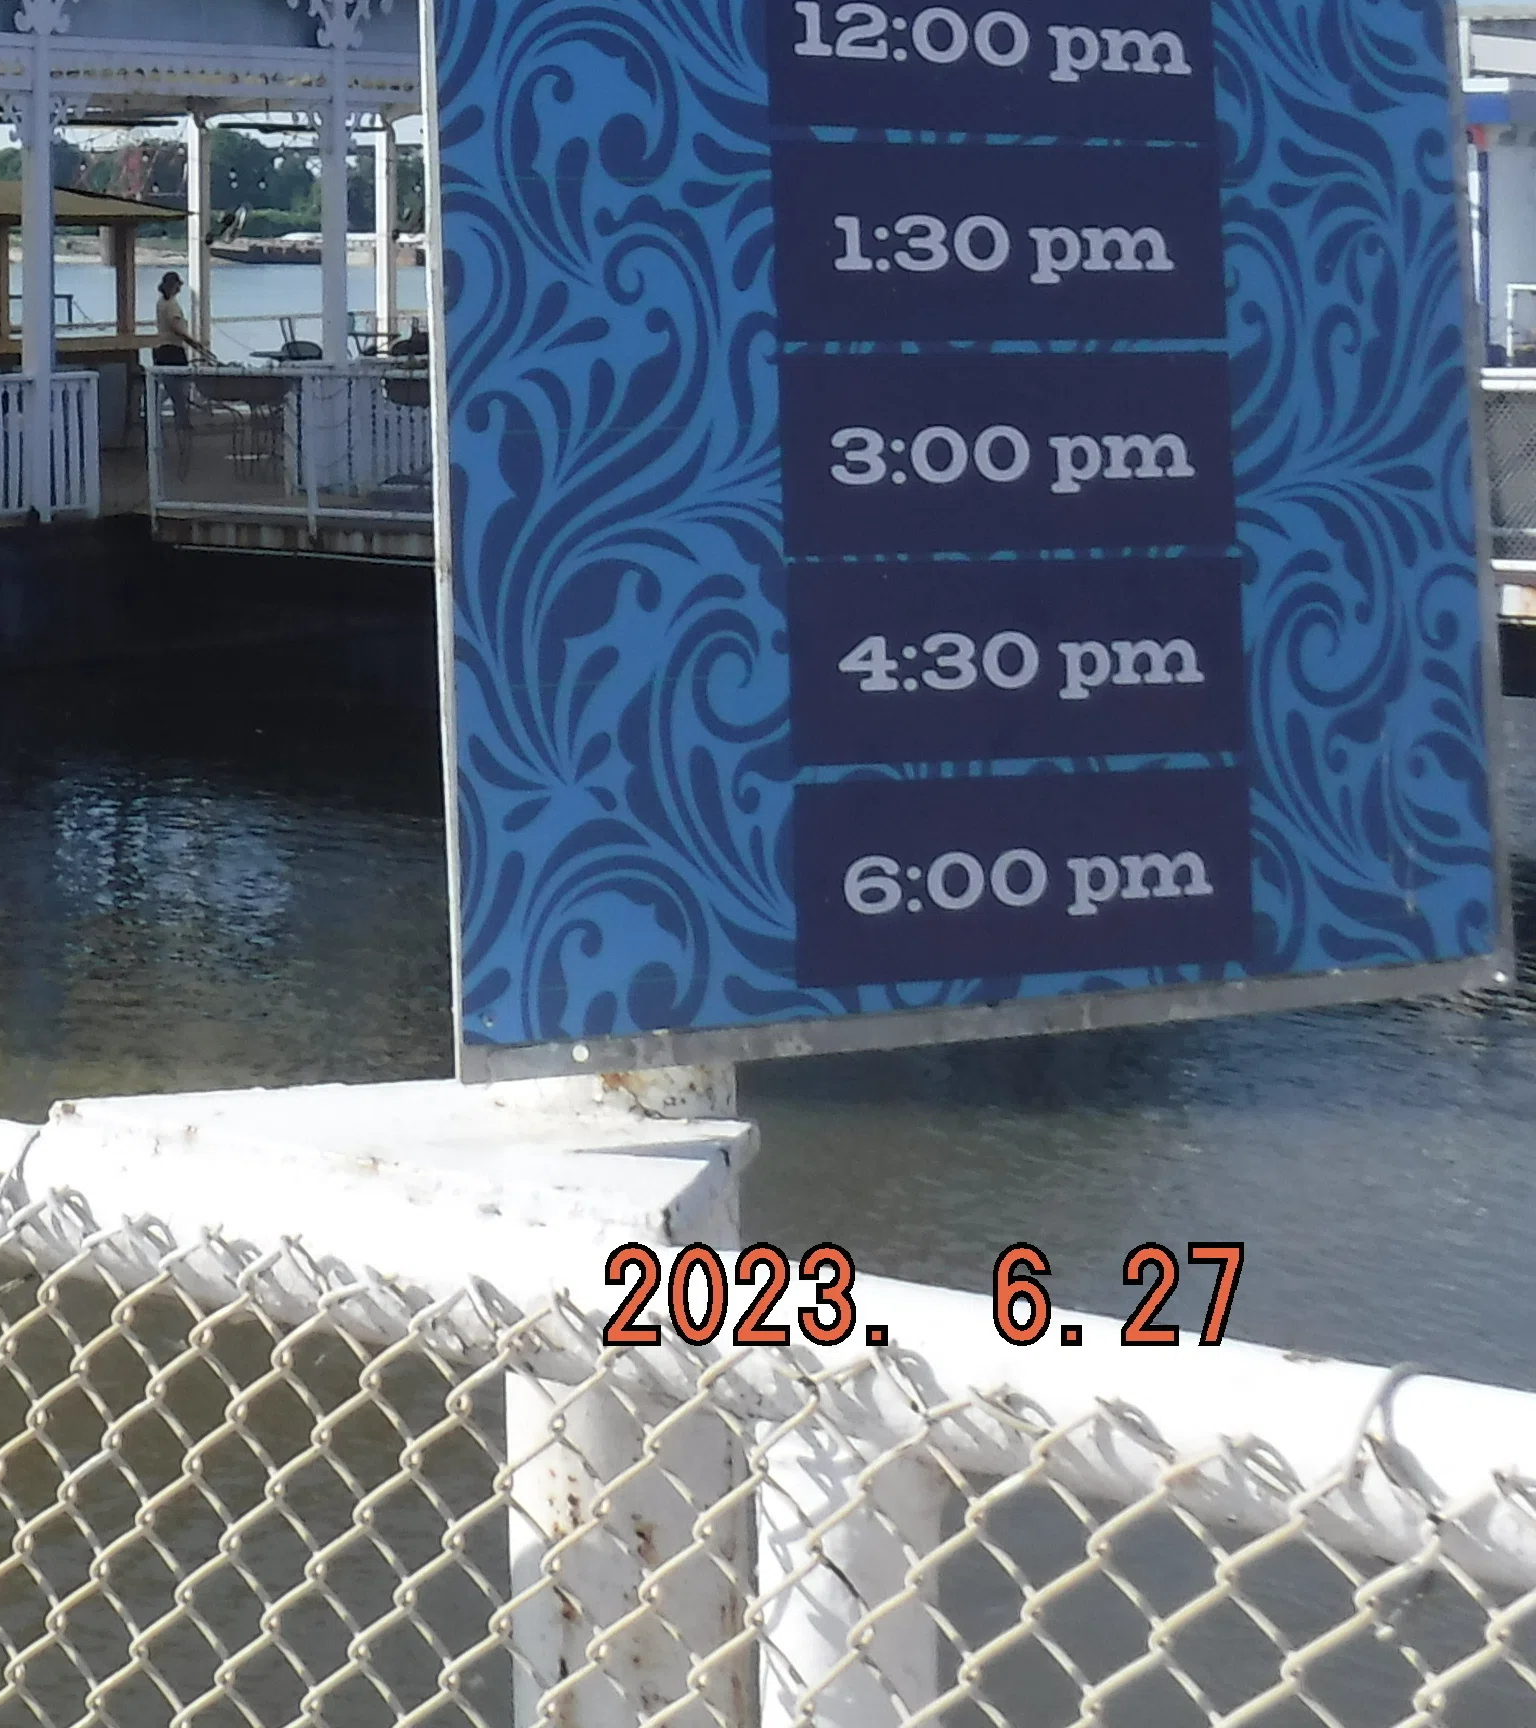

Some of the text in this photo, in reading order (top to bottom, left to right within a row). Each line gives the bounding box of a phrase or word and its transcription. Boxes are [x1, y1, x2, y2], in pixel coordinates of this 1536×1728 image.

[793, 0, 1193, 83] 12:00 pm
[833, 214, 1175, 285] 1:30 pm
[830, 424, 1196, 494] 3:00 pm
[837, 630, 1205, 700] 4:30 pm
[843, 848, 1214, 917] 6:00 pm
